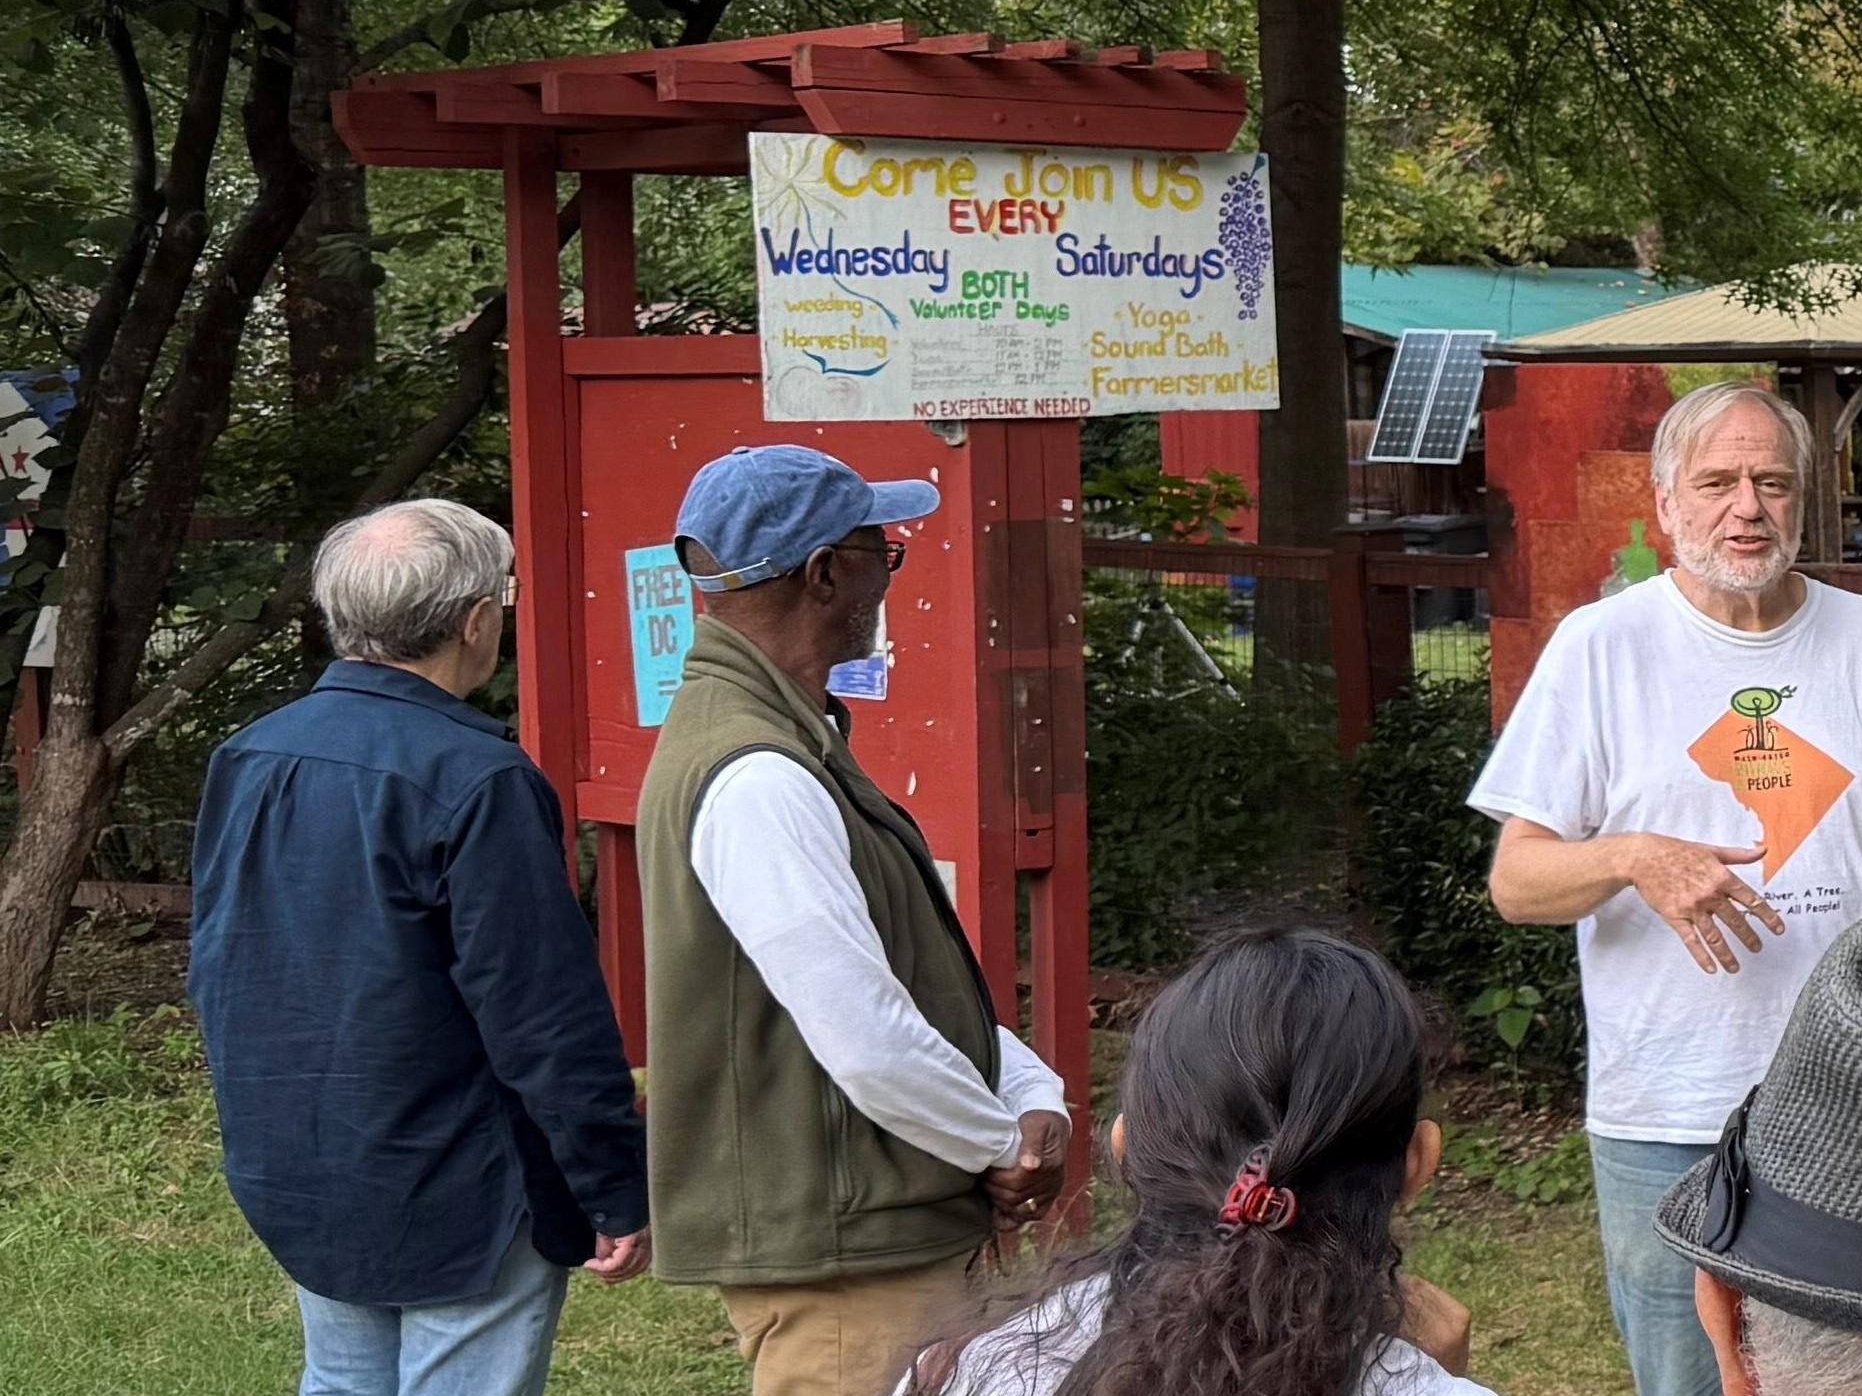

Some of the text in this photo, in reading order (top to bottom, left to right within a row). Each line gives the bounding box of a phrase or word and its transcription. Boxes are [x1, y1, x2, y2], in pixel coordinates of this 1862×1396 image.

[823, 140, 977, 197] Come
[1005, 148, 1112, 202] Join
[949, 199, 1066, 234] EVERY
[761, 227, 1226, 298] Wednesday Saturdays
[961, 270, 1030, 300] BOTH
[910, 299, 1070, 327] Volunteer Days
[1128, 302, 1190, 336] Yoga
[783, 325, 888, 359] Harvesting
[1091, 331, 1229, 358] Sound Bath
[914, 396, 1091, 417] NO EXPERIENCE NEEDED
[632, 565, 686, 611] FREE
[648, 614, 677, 657] DC
[1748, 774, 1792, 791] PEOPLE
